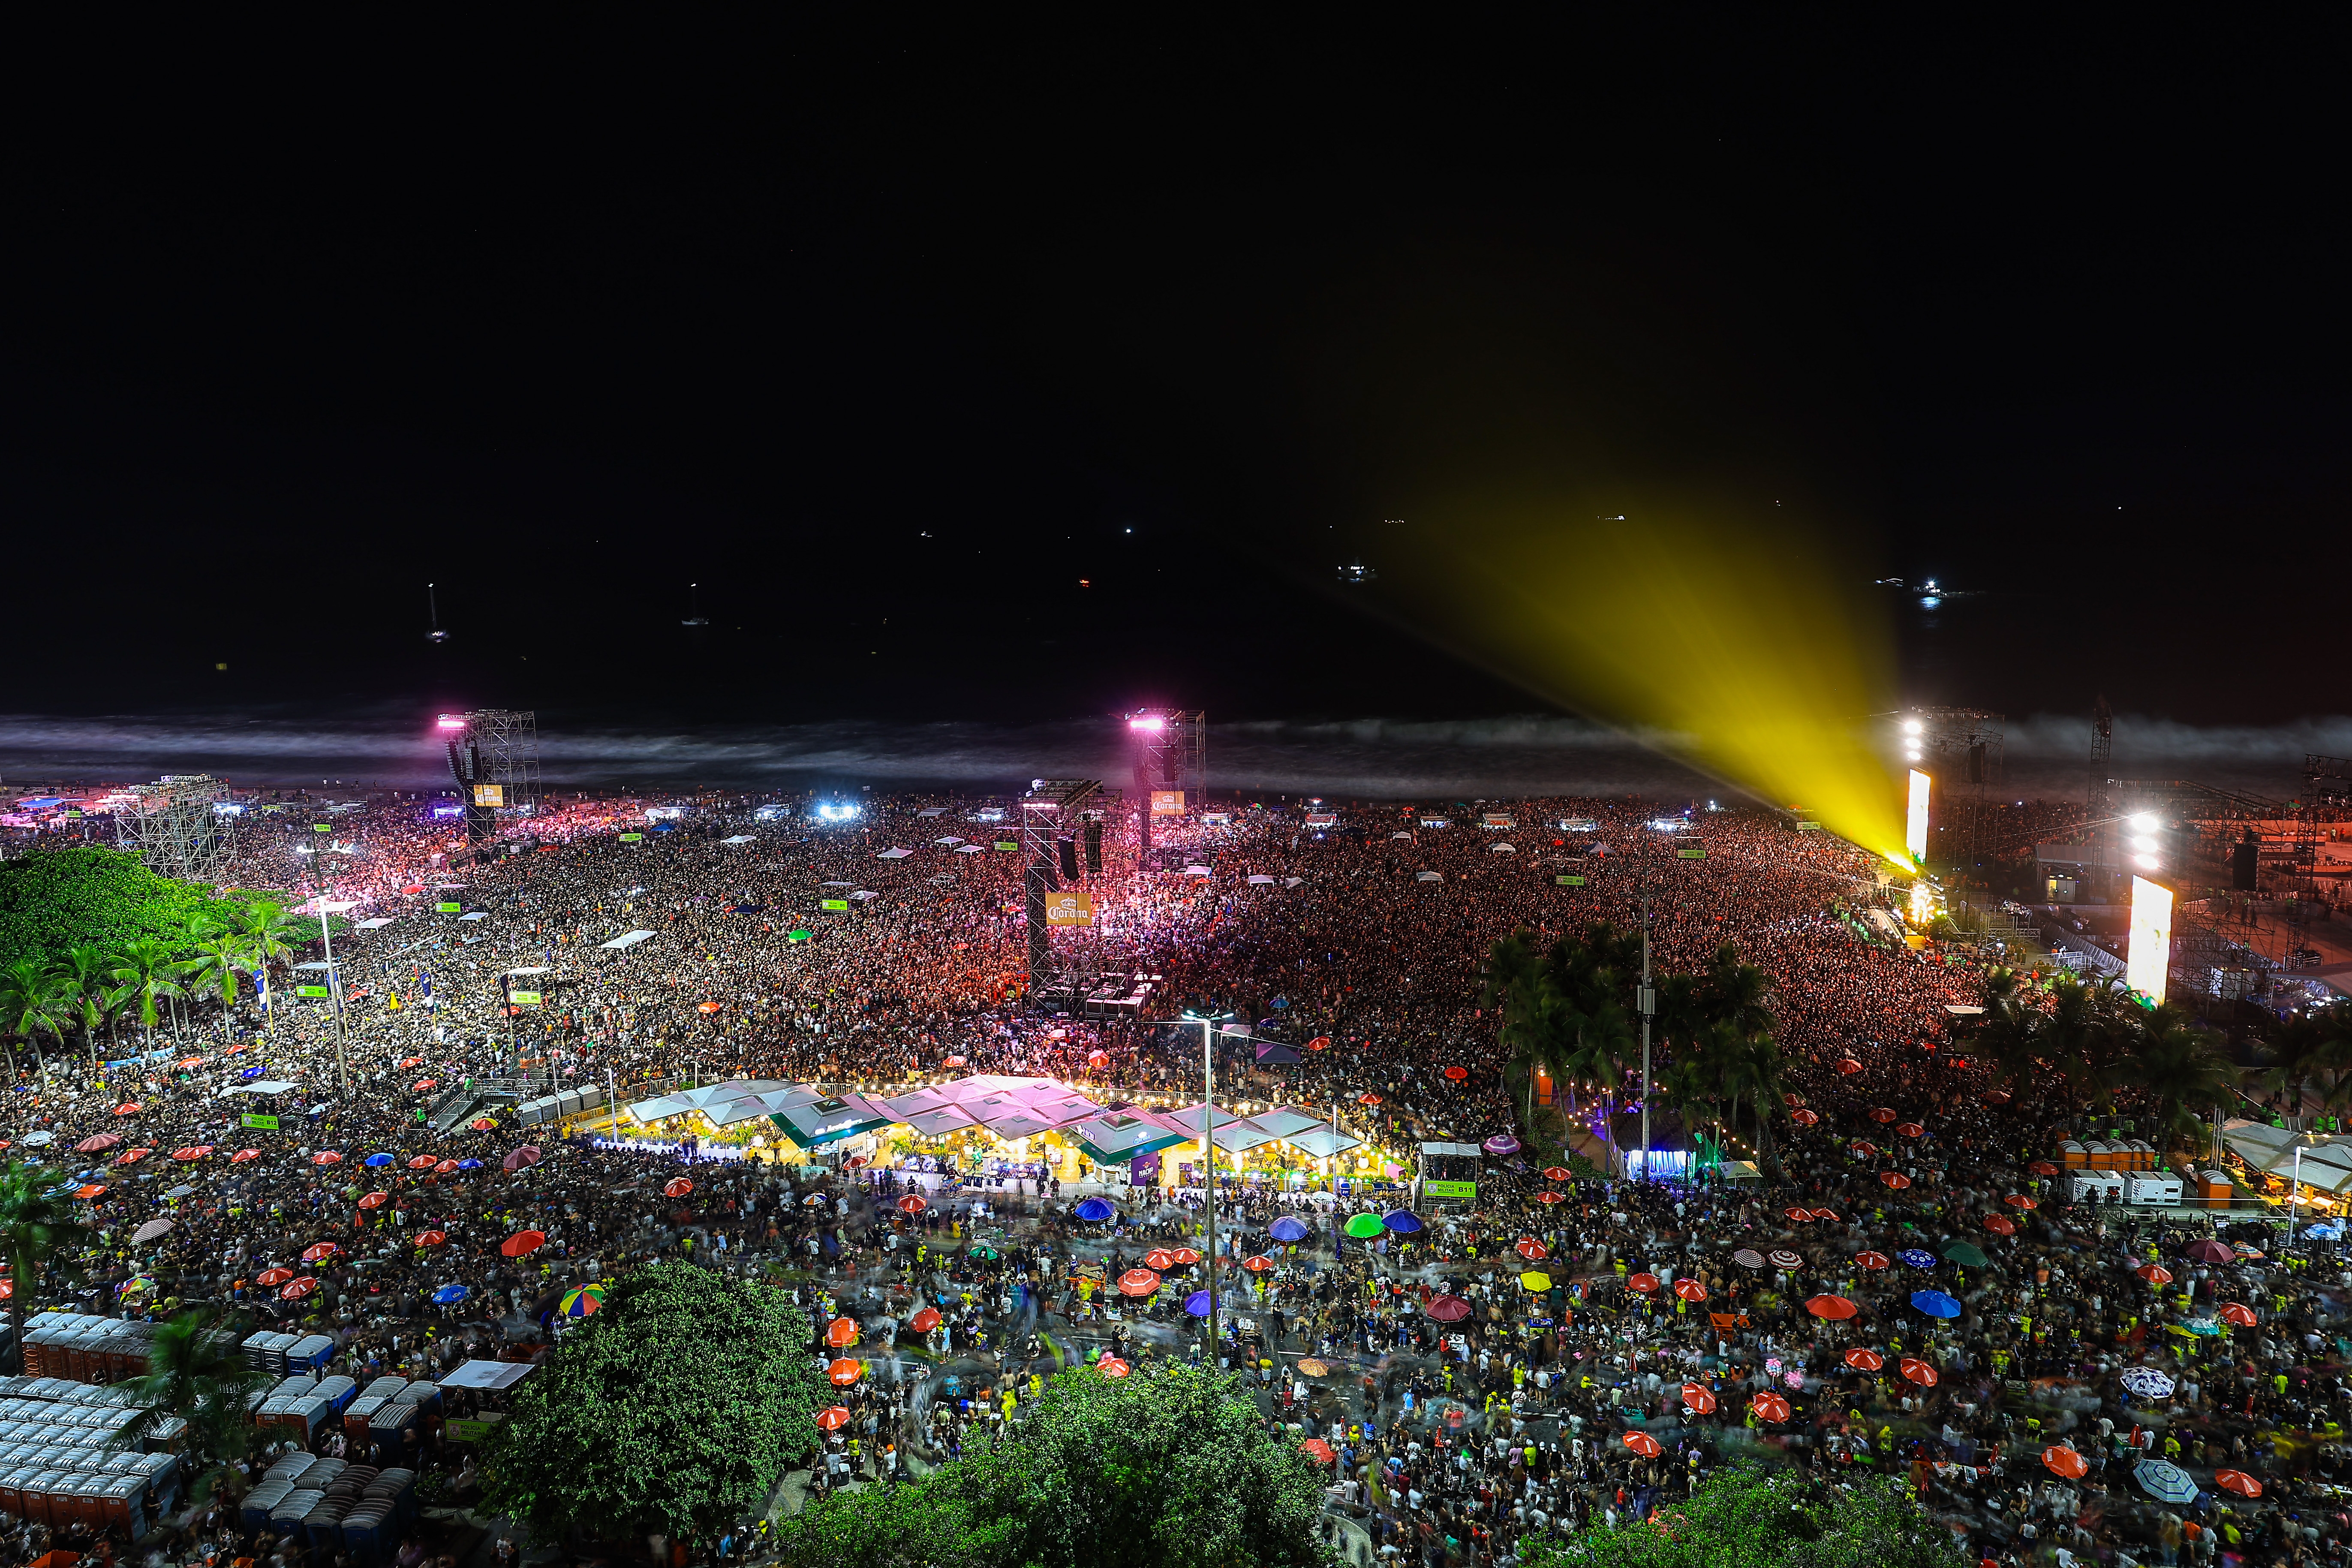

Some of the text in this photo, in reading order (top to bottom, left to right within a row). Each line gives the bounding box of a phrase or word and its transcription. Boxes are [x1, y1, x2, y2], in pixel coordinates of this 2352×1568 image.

[475, 793, 501, 804] Corona
[1152, 801, 1182, 812] Corona
[1047, 906, 1089, 921] Corona
[847, 1141, 863, 1150] Areia
[1139, 1167, 1154, 1177] NACHO
